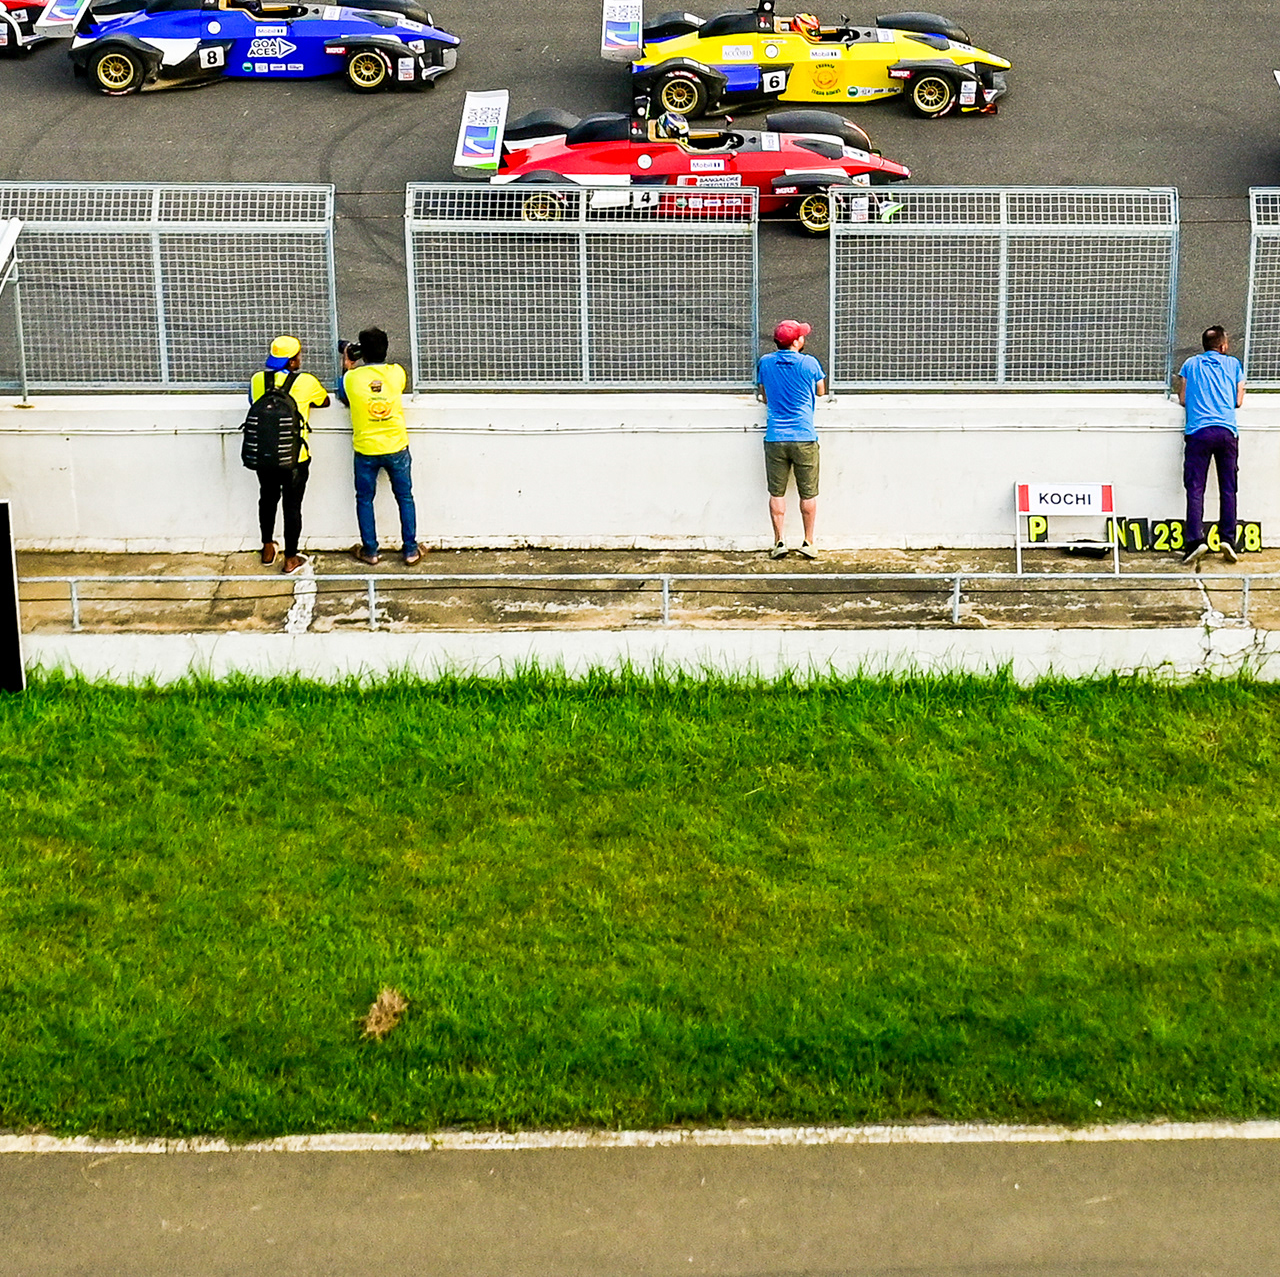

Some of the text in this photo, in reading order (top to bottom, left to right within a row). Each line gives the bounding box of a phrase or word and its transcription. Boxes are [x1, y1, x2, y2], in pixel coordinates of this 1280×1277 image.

[252, 40, 277, 49] GOA
[206, 50, 218, 66] 8
[249, 48, 278, 56] ACES
[769, 75, 781, 89] 6
[692, 161, 714, 169] Mobil
[1039, 493, 1092, 505] KOCHI
[1029, 516, 1047, 542] P
[1153, 523, 1170, 551] 2
[1170, 521, 1184, 550] 3
[1244, 523, 1261, 551] 8
